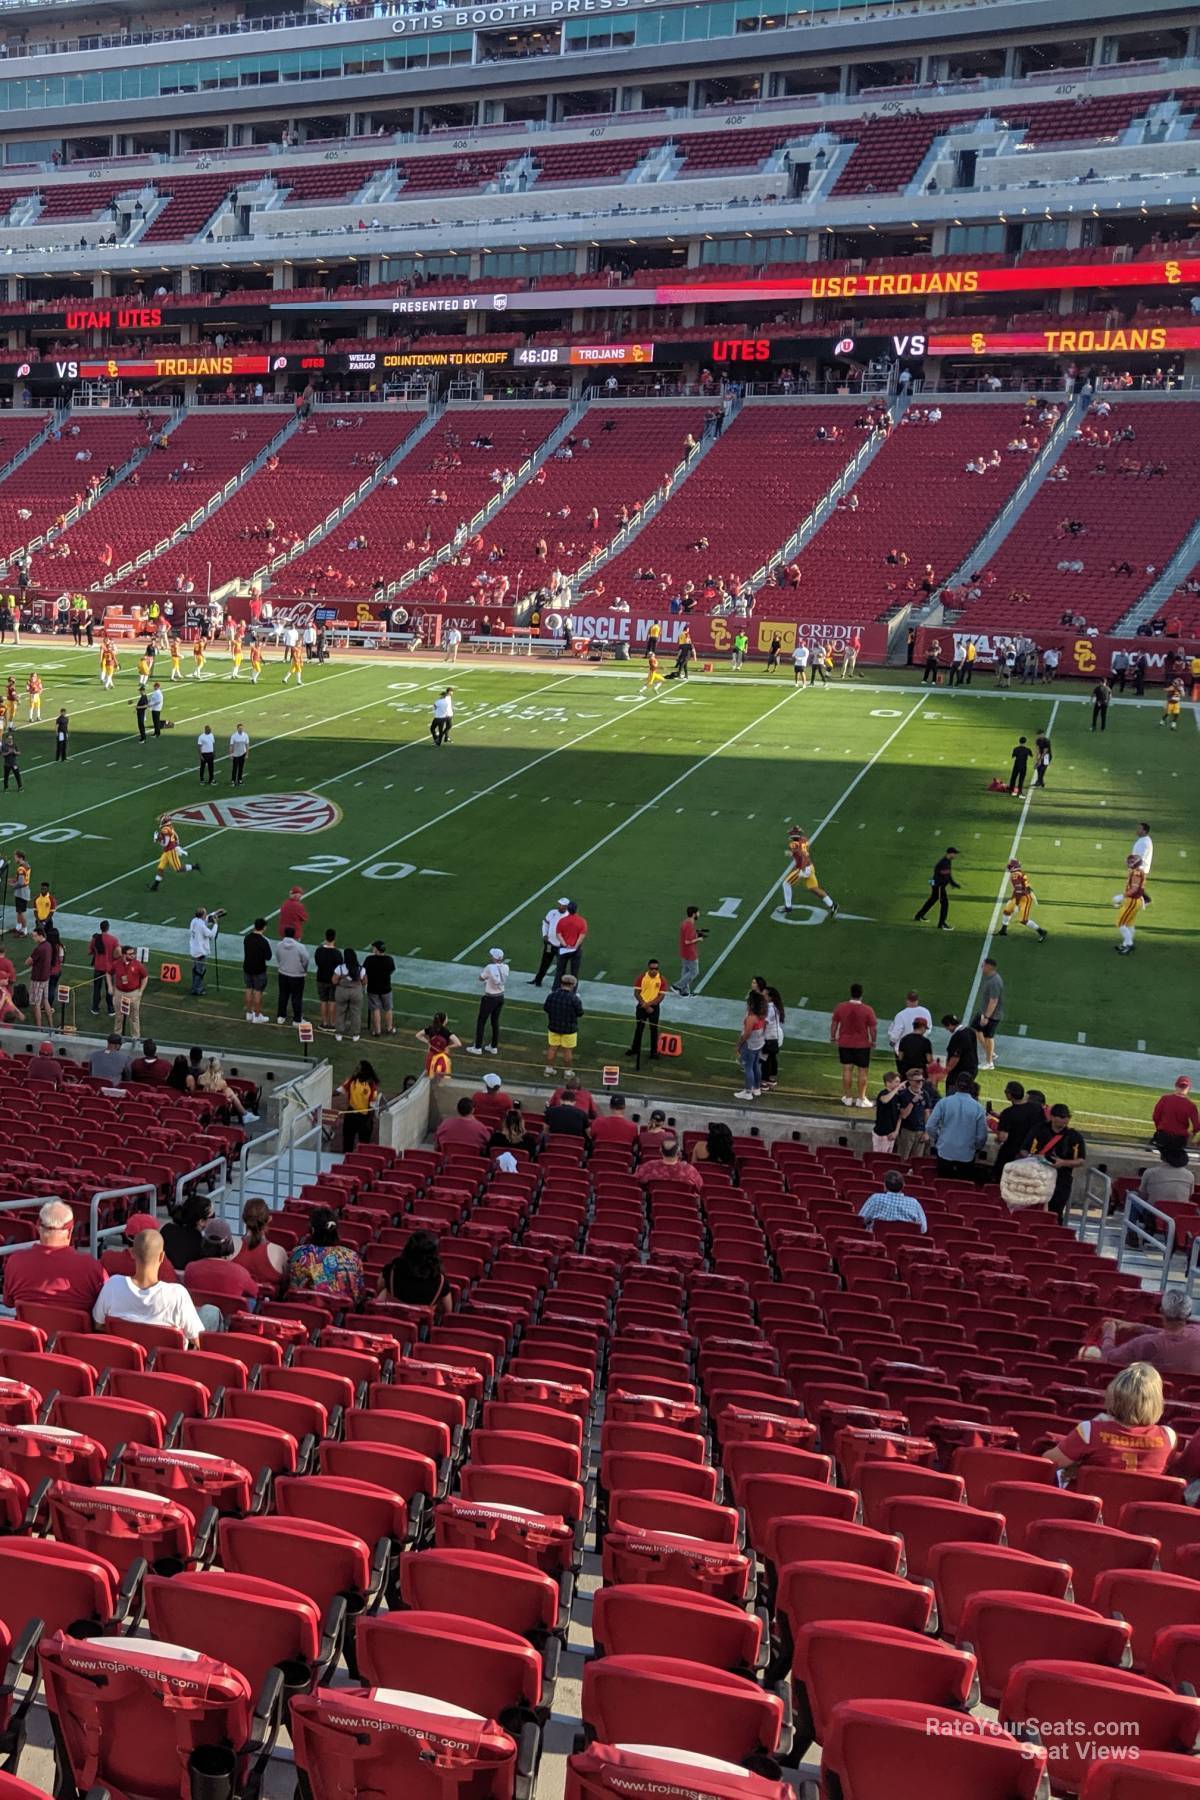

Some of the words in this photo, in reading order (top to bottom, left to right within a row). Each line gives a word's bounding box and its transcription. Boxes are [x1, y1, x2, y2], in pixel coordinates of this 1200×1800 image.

[392, 15, 443, 34] OTIS
[456, 6, 537, 28] BOOTH
[1055, 85, 1072, 95] 410
[881, 102, 899, 111] 409
[725, 116, 742, 125] 408
[589, 128, 605, 137] 407
[452, 140, 468, 149] 406
[324, 151, 339, 160] 405
[811, 276, 857, 298] USC
[865, 272, 979, 296] TROJANS
[392, 300, 459, 313] PRESENTED
[463, 299, 478, 310] BY
[67, 312, 111, 329] UTAH
[118, 309, 162, 327] UTES
[893, 335, 926, 357] VS
[1044, 328, 1167, 352] TROJANS
[349, 353, 376, 362] WELLS
[384, 354, 447, 367] COUNTDOWN
[449, 353, 464, 366] TO
[464, 351, 509, 365] KICKOFF
[519, 348, 559, 364] 46:08
[578, 348, 626, 361] TROJANS
[712, 339, 770, 362] UTES
[56, 361, 78, 378] VS
[155, 356, 233, 376] TROJANS
[349, 361, 376, 371] FARGO
[636, 618, 690, 643] MLK
[798, 623, 865, 639] CREDIT
[1074, 640, 1097, 672] SC
[288, 854, 418, 881] 20
[705, 897, 828, 926] 10
[162, 965, 177, 980] 20
[660, 1035, 679, 1053] 10
[1099, 1431, 1165, 1448] TROJANS
[1121, 1452, 1138, 1472] 1
